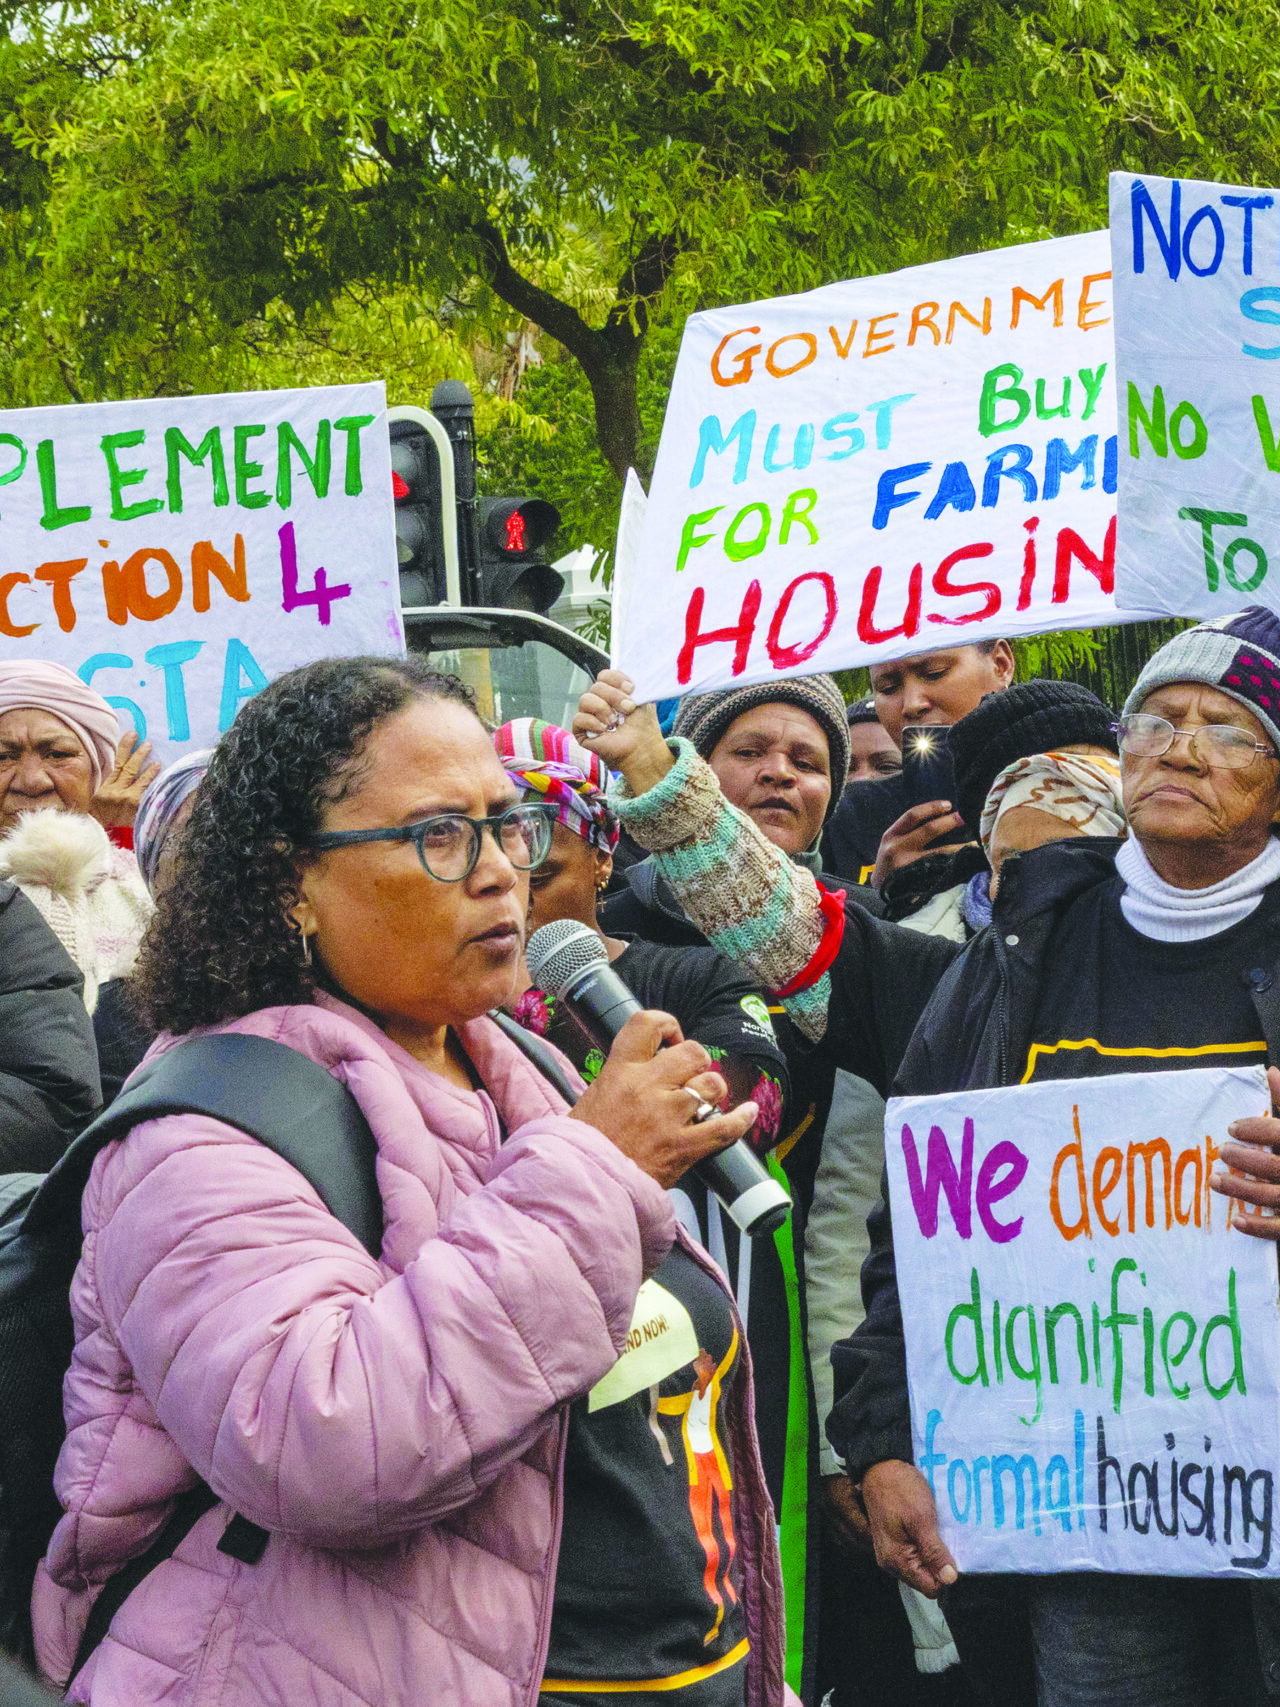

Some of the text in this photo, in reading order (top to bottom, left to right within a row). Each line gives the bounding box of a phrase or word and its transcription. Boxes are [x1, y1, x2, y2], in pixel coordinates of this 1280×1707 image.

[278, 521, 352, 626] 4
[676, 488, 820, 572] FOR
[902, 1117, 1029, 1244] We
[944, 1257, 1247, 1426] dignified
[920, 1409, 1274, 1569] formal housing
